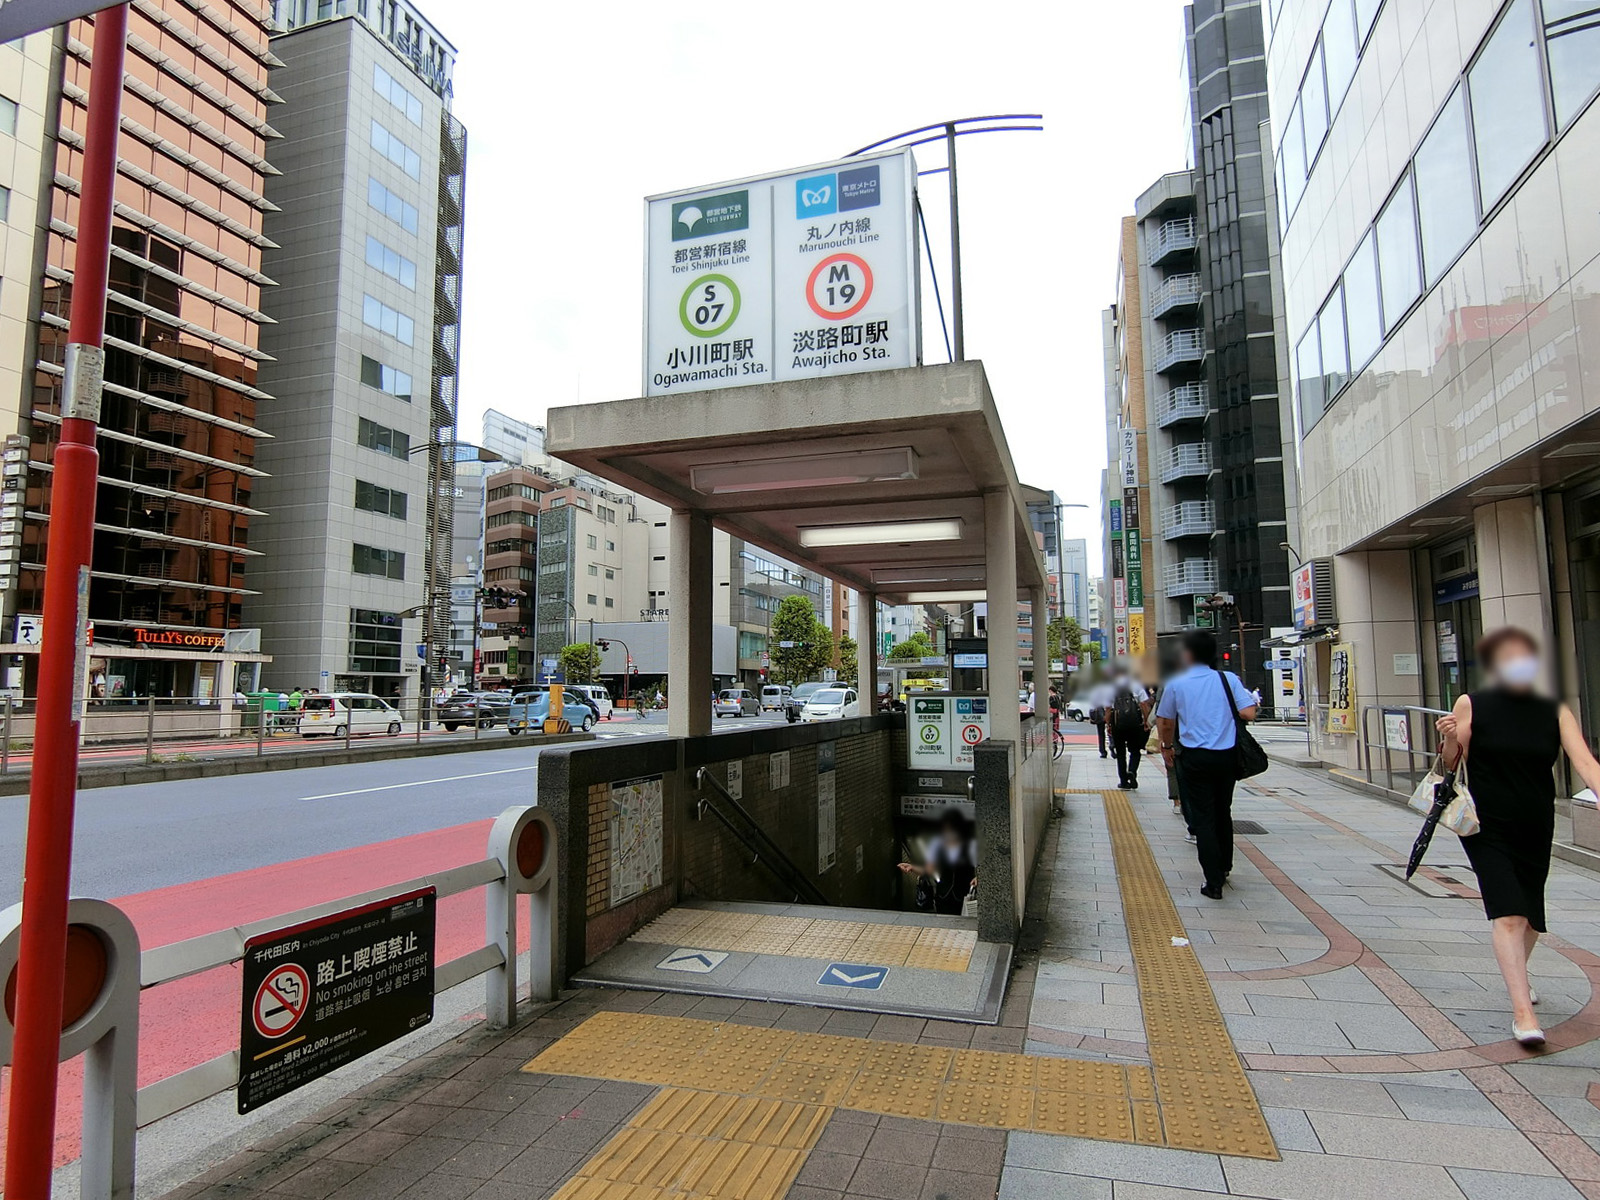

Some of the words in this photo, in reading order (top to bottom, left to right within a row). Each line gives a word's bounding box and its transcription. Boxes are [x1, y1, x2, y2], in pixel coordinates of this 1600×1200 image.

[842, 180, 876, 192] 東京メトロ
[706, 204, 742, 218] 都営地下鉄
[720, 212, 742, 222] SUBWAY
[807, 217, 871, 242] 丸ノ内線
[674, 239, 747, 264] 都営新宿線
[799, 236, 856, 254] Marunouchi
[859, 234, 880, 244] Line
[672, 265, 688, 274] Toei
[692, 258, 728, 270] Shinjuku
[732, 254, 750, 264] Line
[828, 264, 850, 284] M
[704, 284, 716, 302] S
[826, 283, 856, 306] 19
[695, 303, 724, 324] 07
[792, 320, 889, 353] 淡路町駅
[666, 338, 755, 370] 小川町駅
[792, 347, 858, 370] Awajicho
[862, 345, 891, 360] Sta.
[653, 366, 738, 388] Ogawamachi
[742, 360, 768, 376] Sta.
[1124, 431, 1134, 484] カルフール神田
[134, 628, 182, 644] TULLY'S
[254, 940, 300, 964] 千代田区内
[309, 936, 330, 948] Chiyoda
[330, 932, 340, 940] City
[316, 930, 418, 986] 路上喫煙禁止
[316, 990, 330, 1004] No
[332, 974, 373, 1000] smoking
[375, 969, 388, 982] on
[388, 961, 403, 974] the
[404, 951, 428, 968] street
[412, 966, 428, 982] 금지
[284, 1048, 301, 1065] 過料
